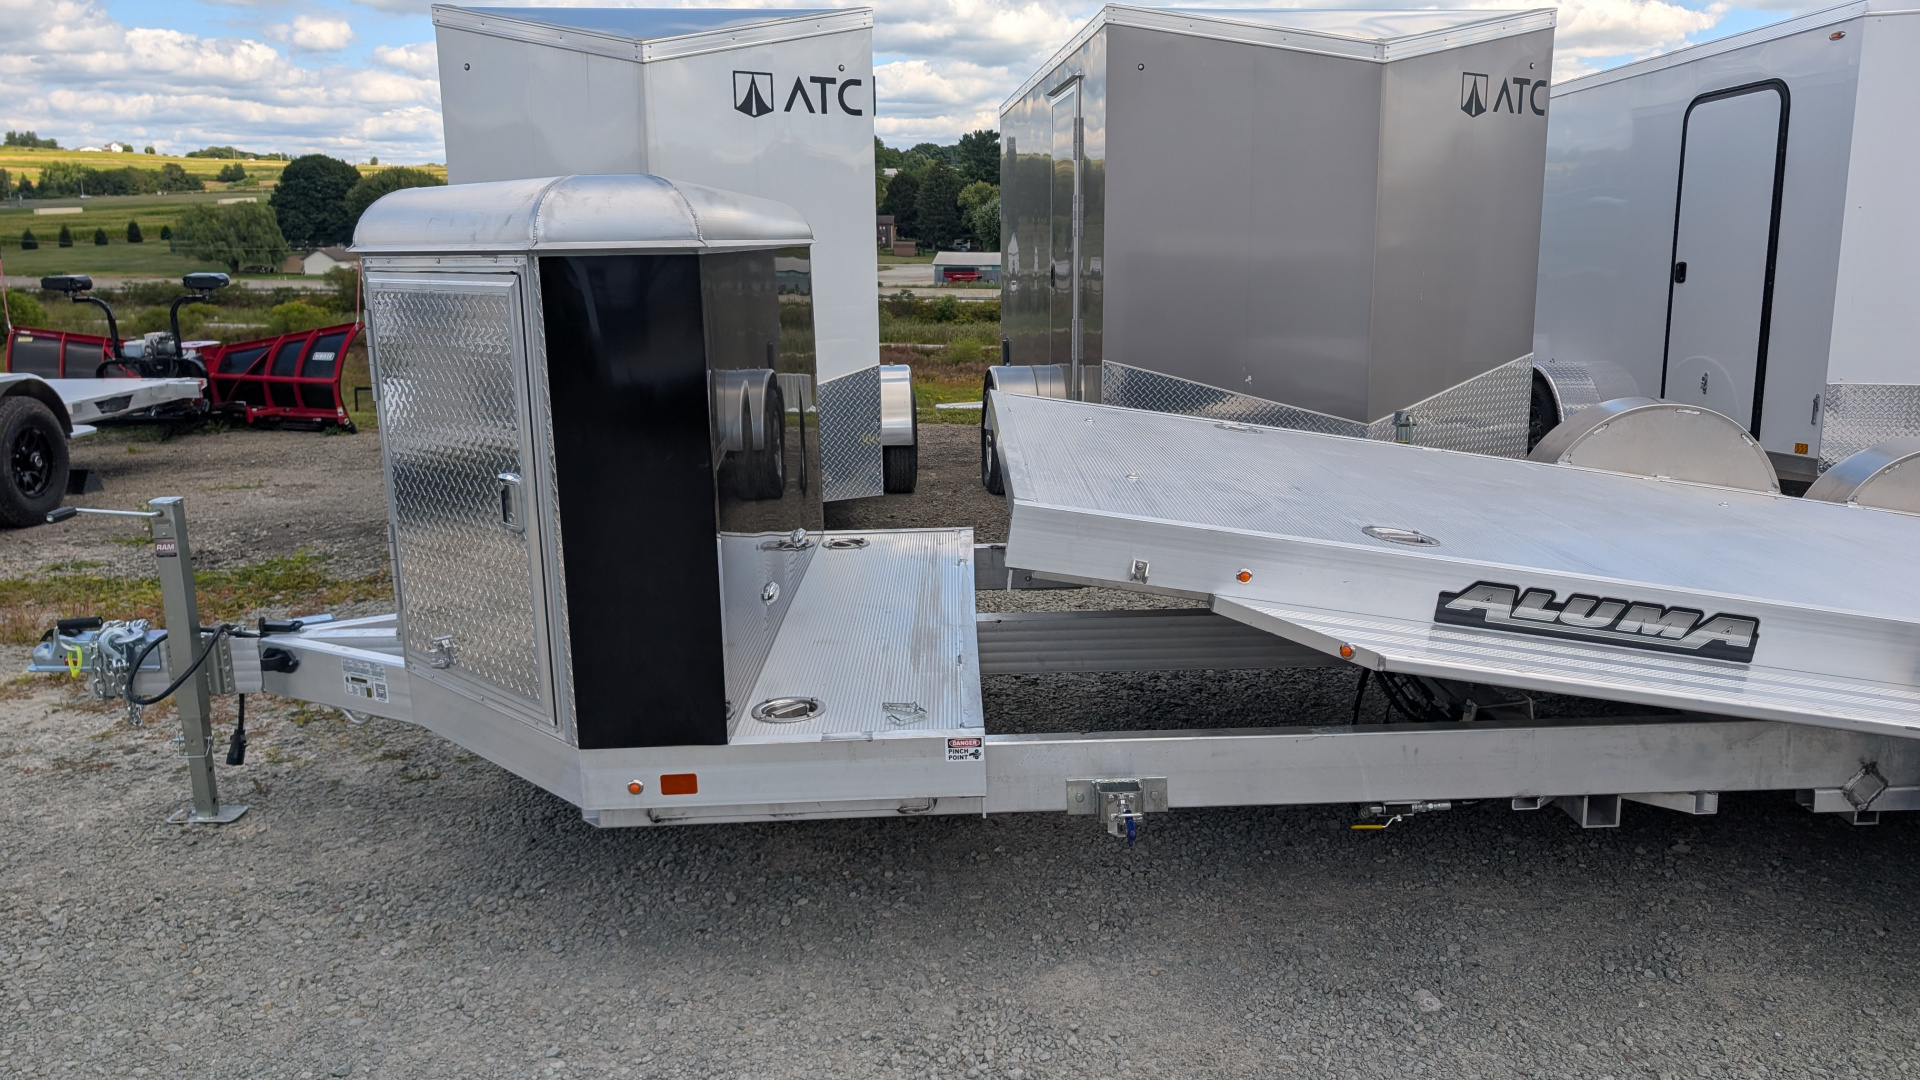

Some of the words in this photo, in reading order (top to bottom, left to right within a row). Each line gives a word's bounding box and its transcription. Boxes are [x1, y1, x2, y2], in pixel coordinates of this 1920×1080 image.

[784, 75, 863, 117] ATC
[1493, 76, 1547, 116] ATC
[156, 543, 175, 551] RAM
[1445, 584, 1756, 649] ALUMA
